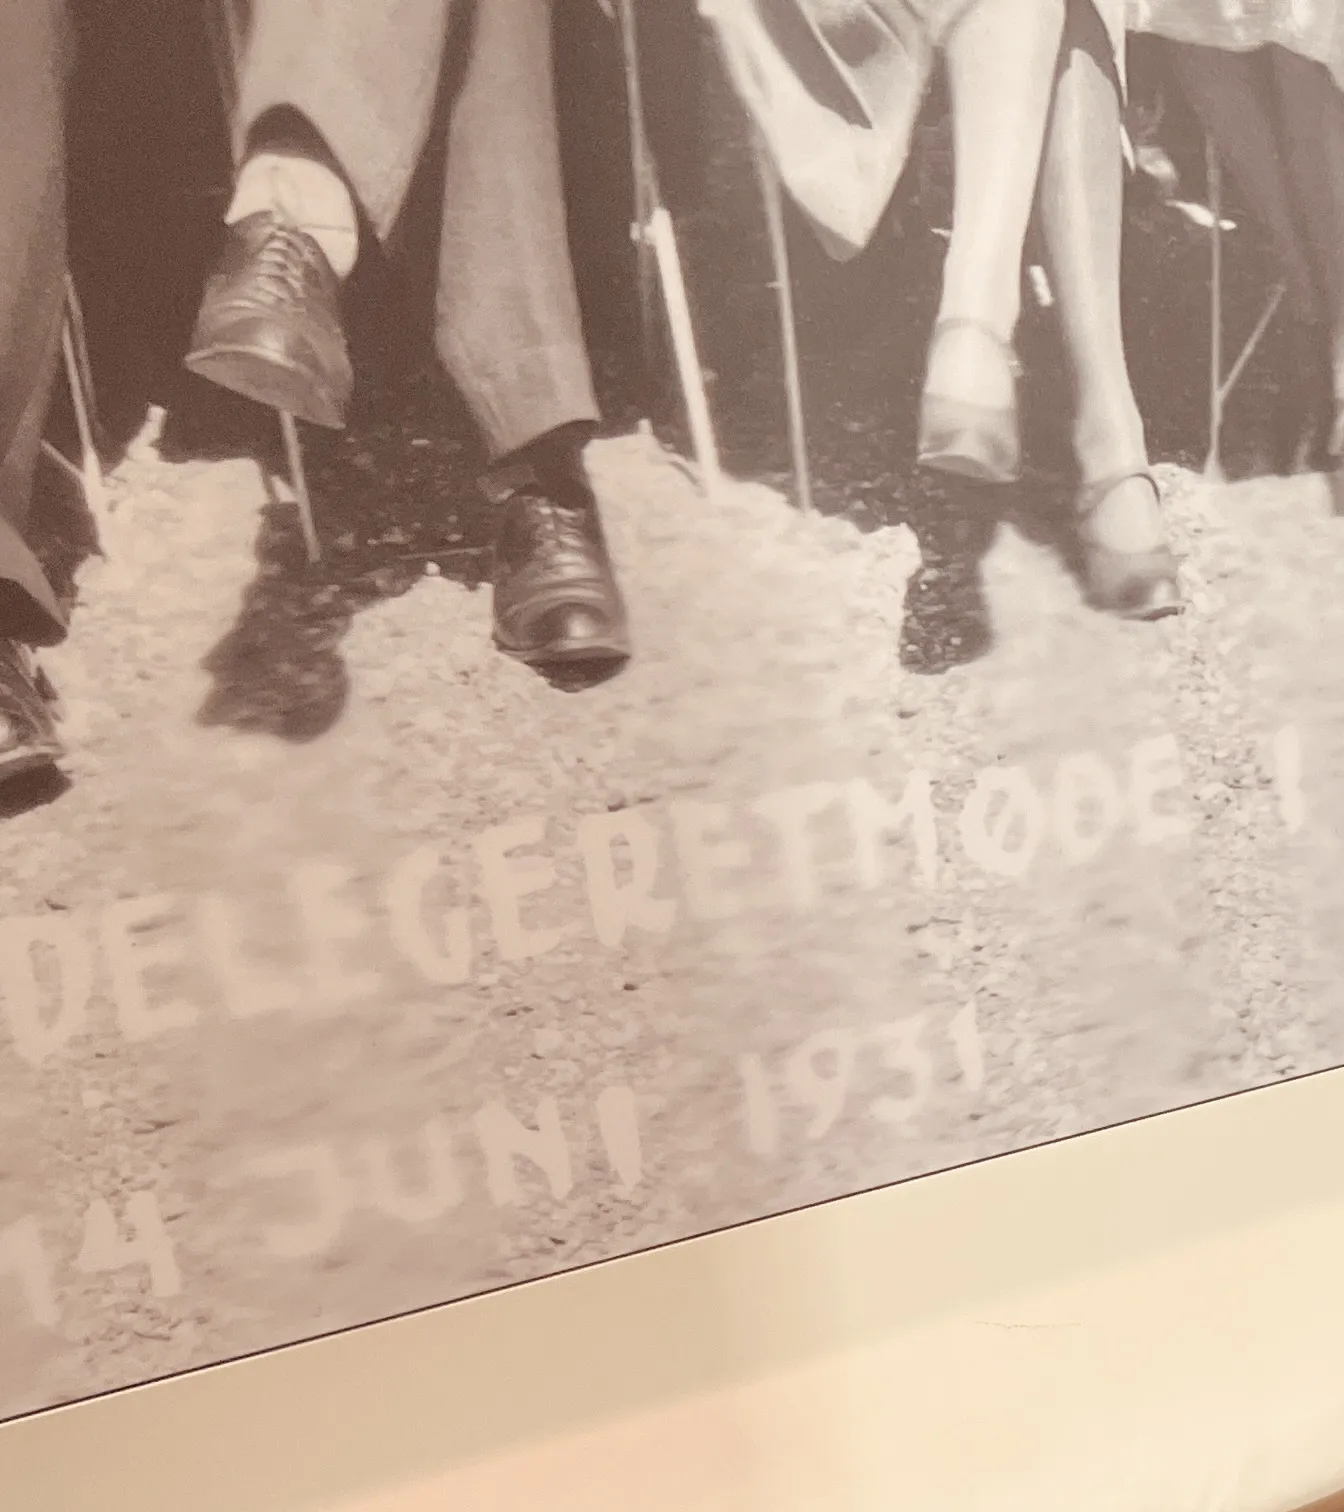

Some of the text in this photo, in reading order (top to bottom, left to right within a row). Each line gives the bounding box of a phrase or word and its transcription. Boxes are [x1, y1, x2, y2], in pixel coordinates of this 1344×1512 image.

[2, 732, 1192, 1064] DELEGERETMØDE
[1271, 724, 1306, 833] I
[214, 1086, 646, 1256] JUNI
[738, 1001, 984, 1156] 1931
